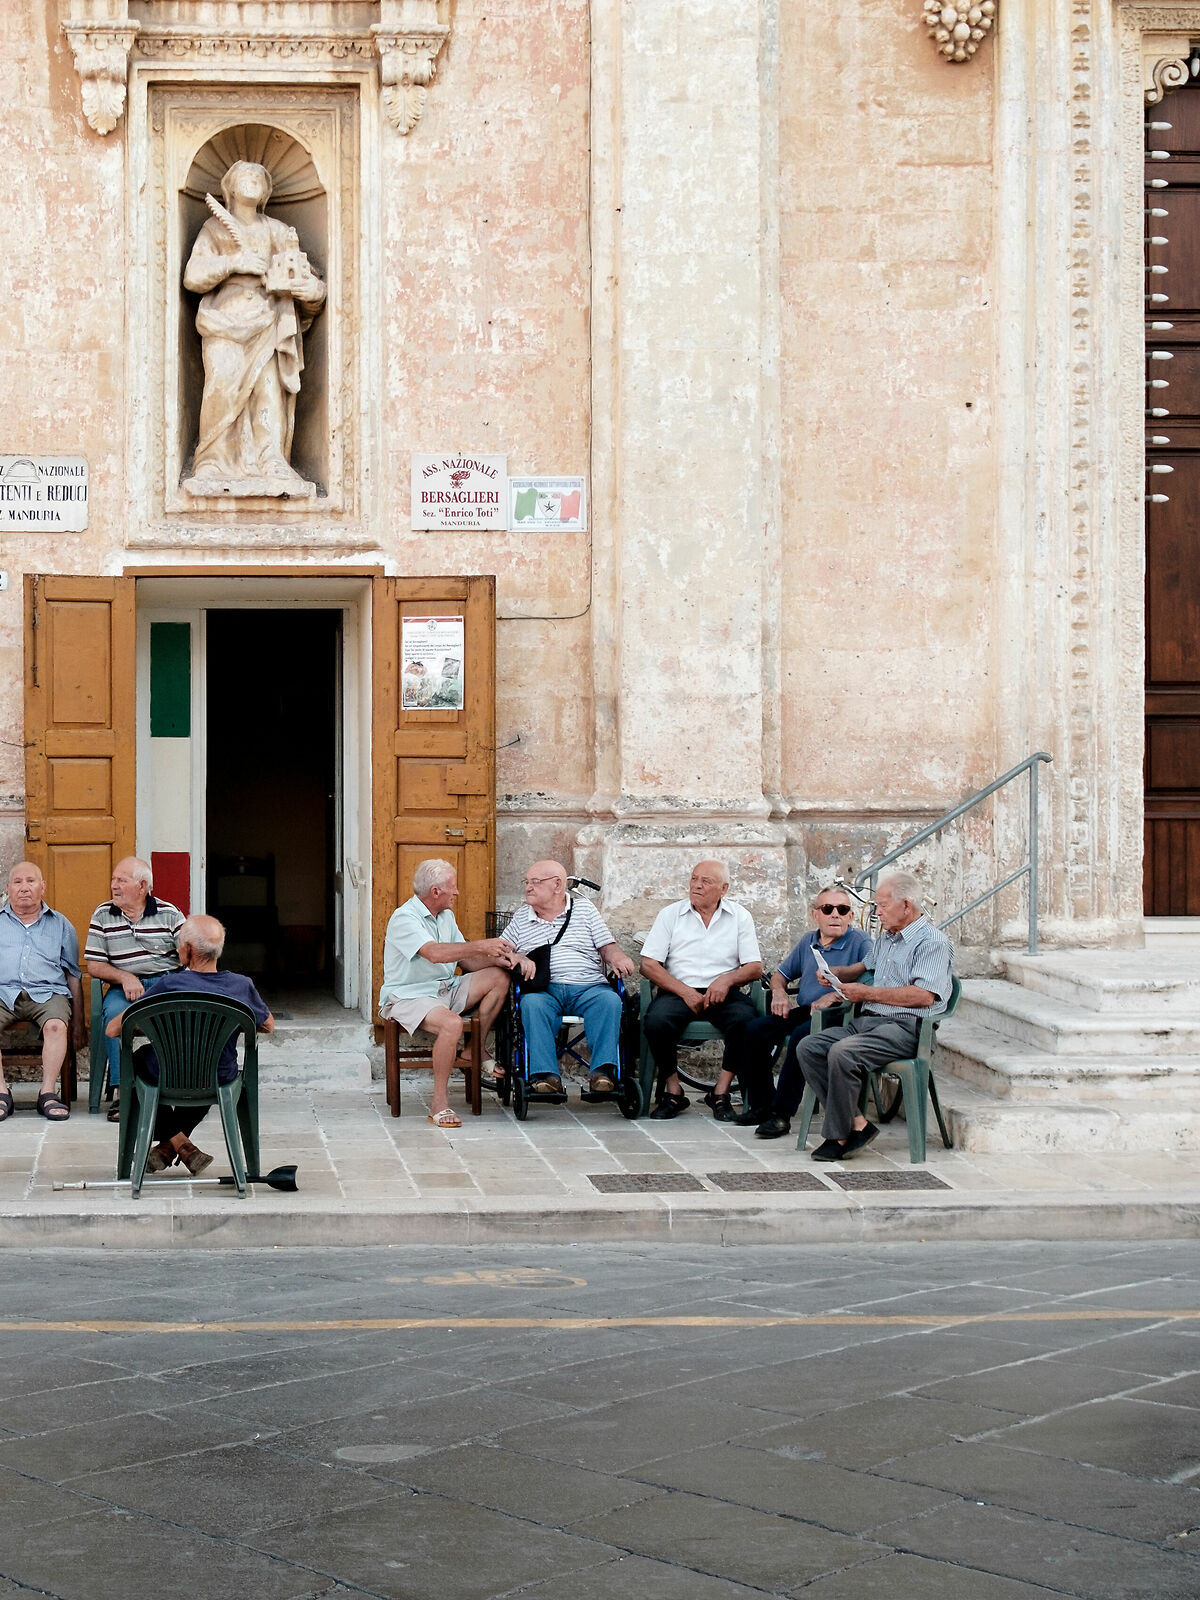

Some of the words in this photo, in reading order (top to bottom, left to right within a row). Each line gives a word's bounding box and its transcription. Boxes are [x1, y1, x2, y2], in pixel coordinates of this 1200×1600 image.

[38, 465, 86, 477] NAZIONALE
[422, 464, 441, 479] ASS.
[442, 458, 499, 480] NAZIONALE
[47, 485, 87, 501] REDUCI
[421, 491, 499, 503] BERSAGLIERI
[8, 510, 61, 520] MANDURIA
[422, 509, 436, 518] Sez.
